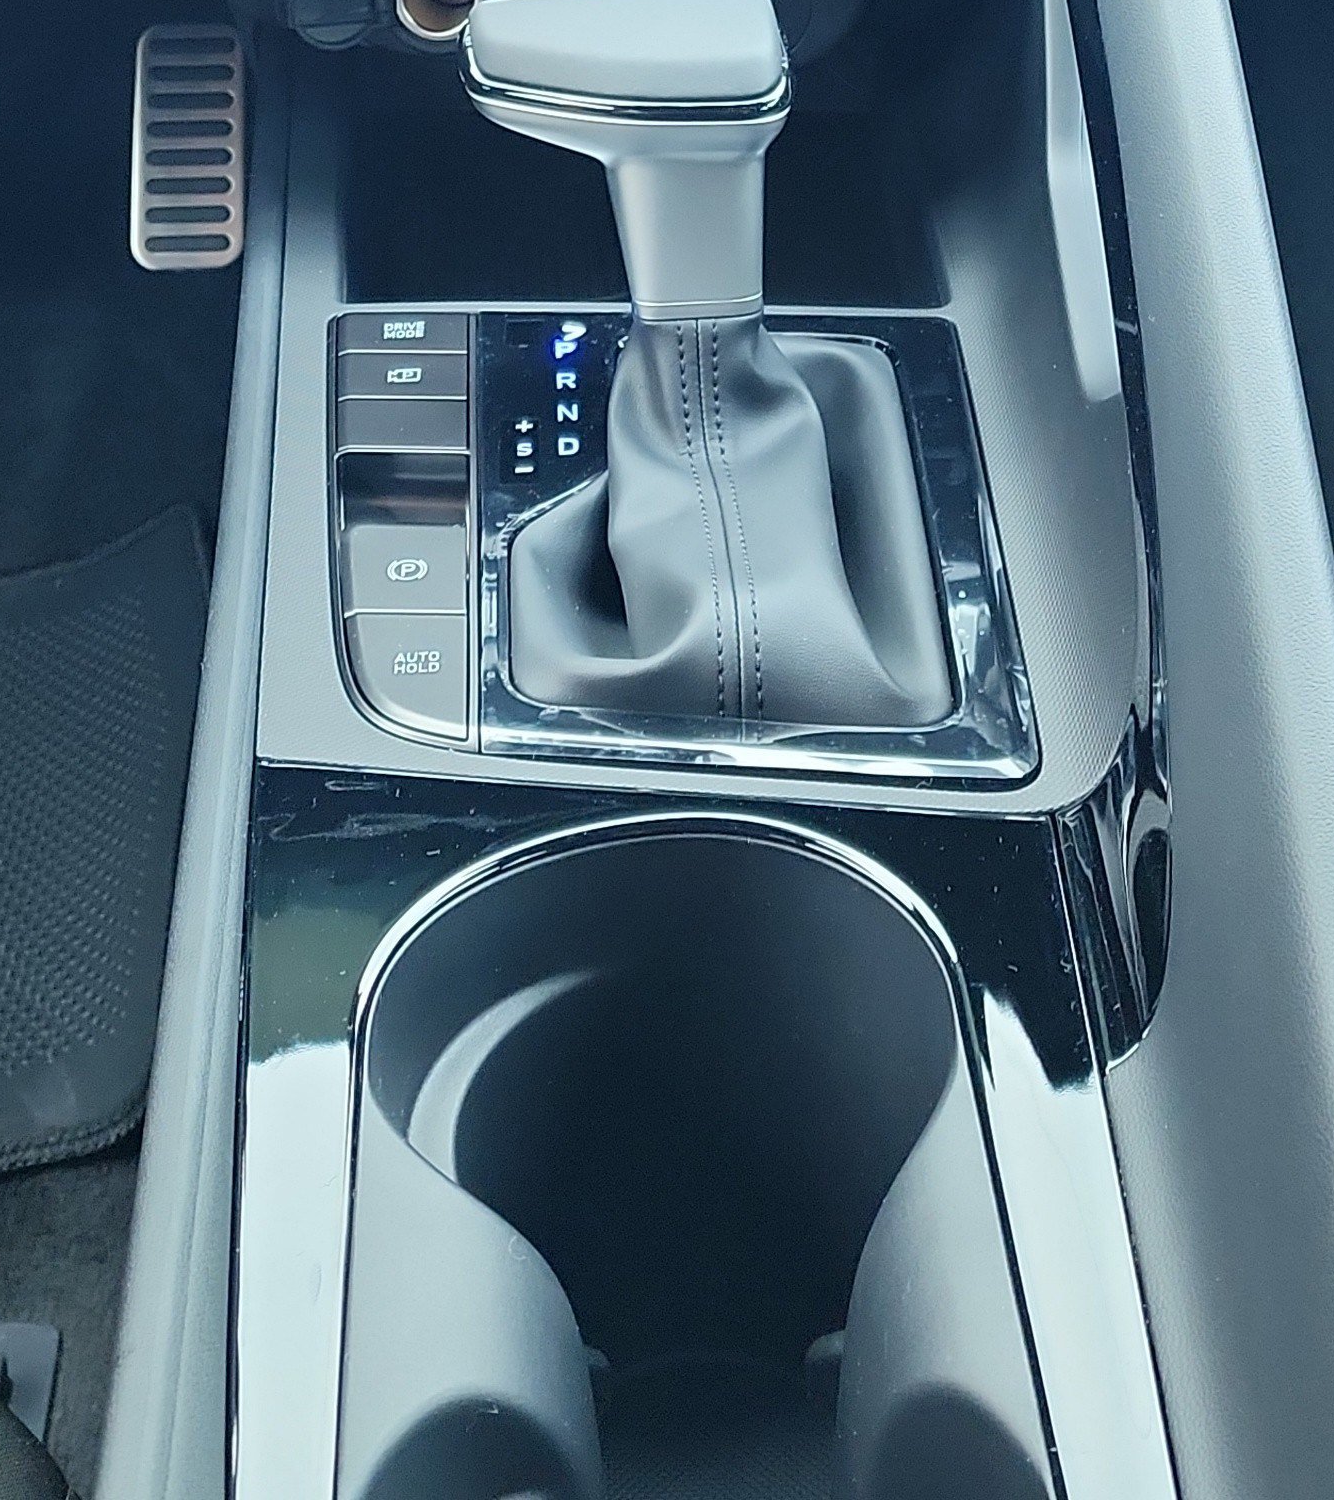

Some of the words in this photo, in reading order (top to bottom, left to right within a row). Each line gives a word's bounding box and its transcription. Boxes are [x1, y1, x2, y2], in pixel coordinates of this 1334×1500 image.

[554, 339, 579, 360] P
[555, 371, 577, 389] R
[556, 403, 579, 422] N
[516, 442, 534, 457] S
[557, 436, 580, 456] D
[393, 650, 441, 663] AUTO
[393, 661, 440, 674] HOLD
